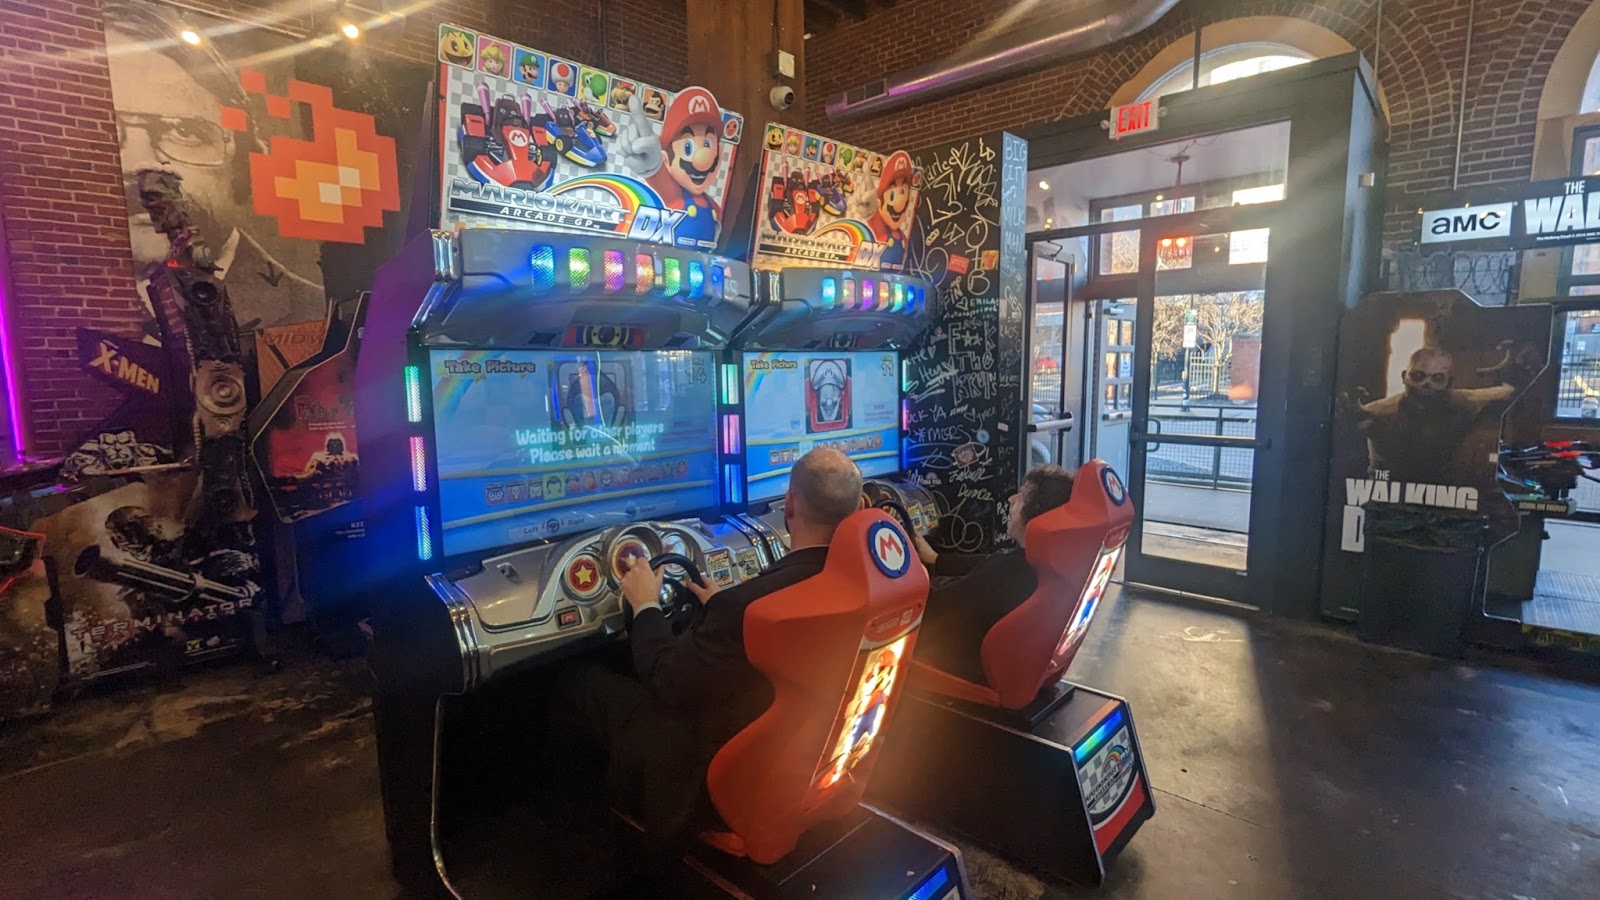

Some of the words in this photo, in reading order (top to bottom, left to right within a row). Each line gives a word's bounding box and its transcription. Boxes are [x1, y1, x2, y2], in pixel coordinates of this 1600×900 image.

[1117, 101, 1152, 134] EXIT
[1005, 137, 1027, 162] BIG
[1002, 163, 1027, 190] CITY
[1564, 180, 1586, 195] THE
[500, 205, 566, 224] ARCADE
[628, 204, 688, 246] DX
[1002, 206, 1026, 230] MILK
[784, 248, 821, 259] ARCADE
[854, 241, 887, 271] DX
[89, 341, 160, 394] X-MEN
[444, 360, 482, 373] Take
[485, 359, 536, 373] Picture
[750, 360, 769, 370] Take
[771, 359, 798, 369] Picture
[515, 429, 567, 446] Waiting
[569, 423, 588, 441] for
[625, 422, 665, 438] players
[529, 448, 574, 464] Please
[575, 443, 600, 458] wait
[603, 446, 612, 455] a
[612, 440, 656, 454] moment
[1374, 469, 1390, 481] THE
[523, 526, 539, 535] Left
[71, 598, 254, 641] TERMINATOR
